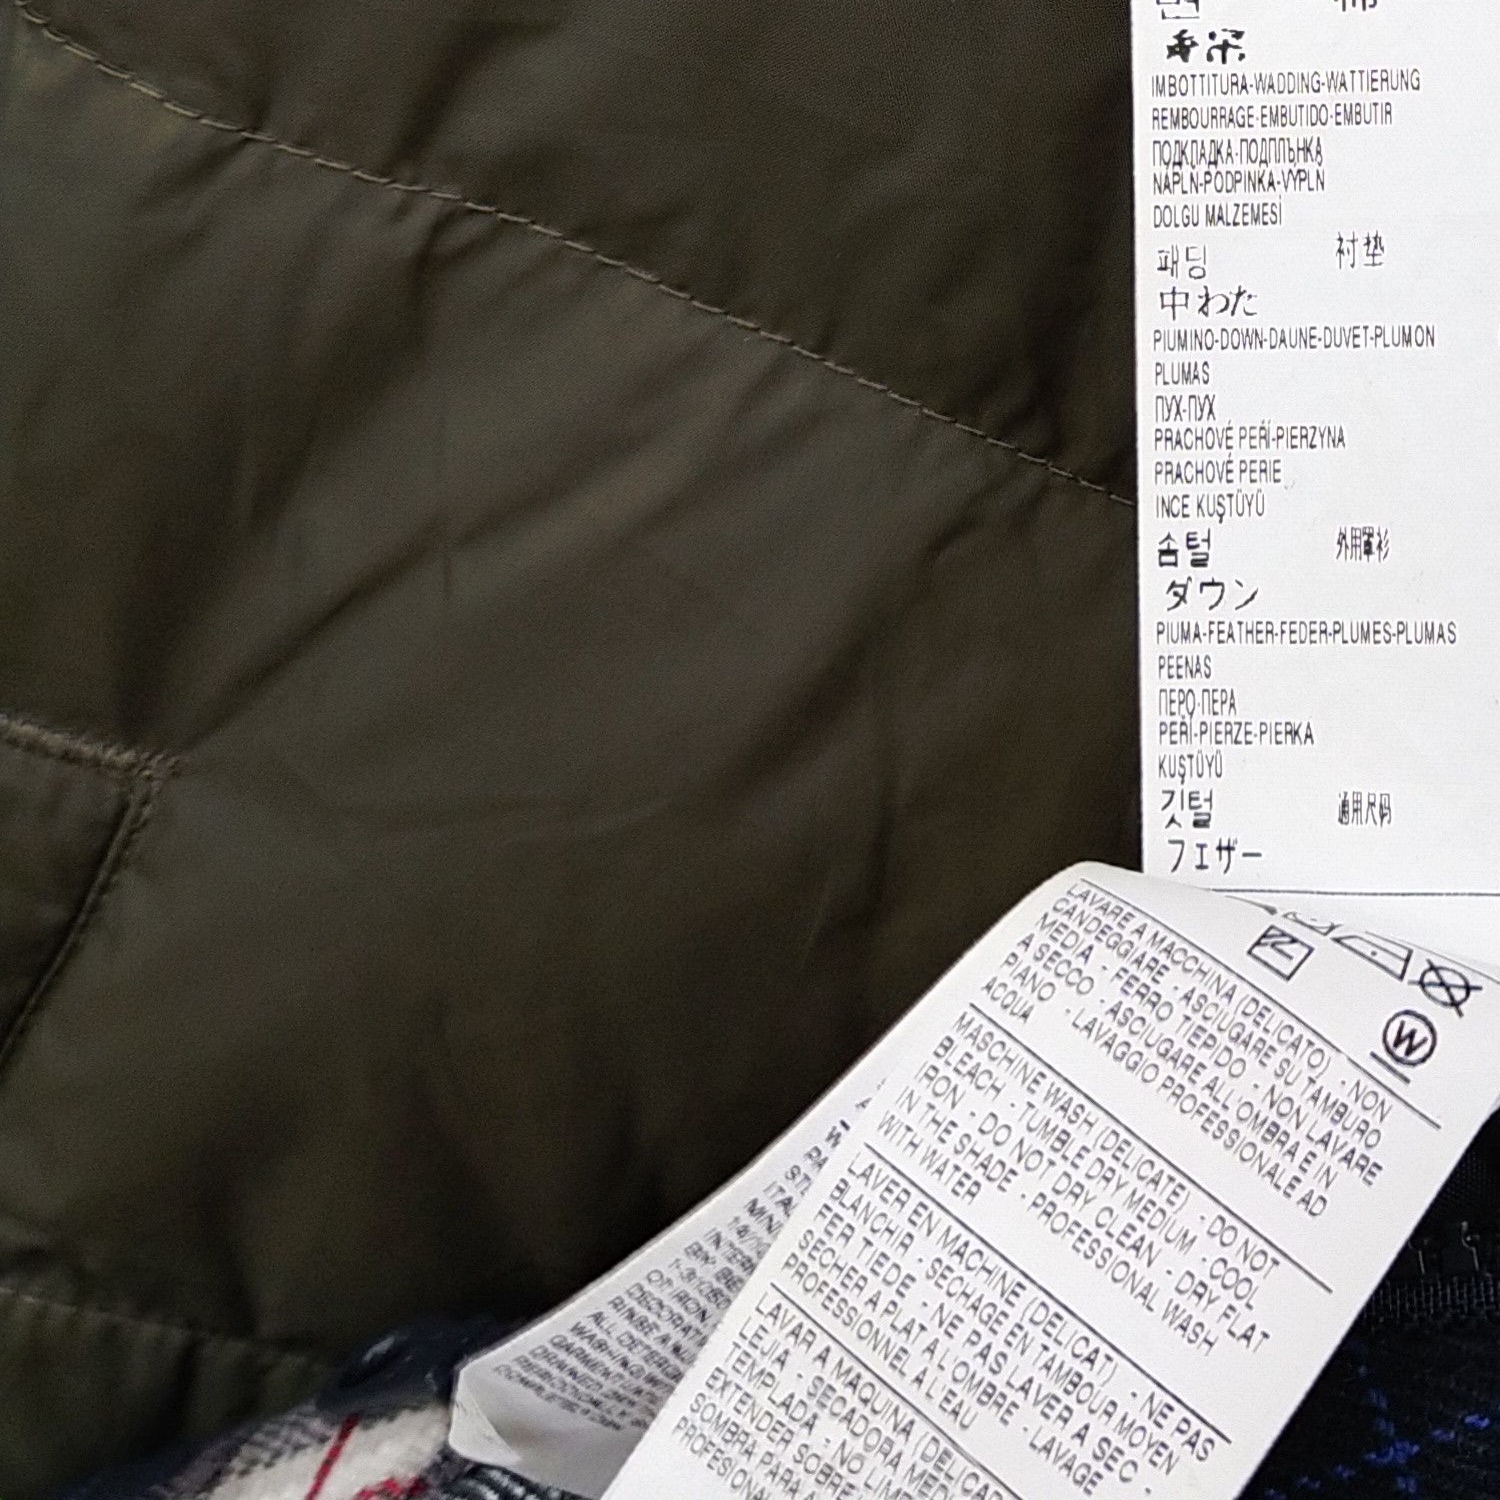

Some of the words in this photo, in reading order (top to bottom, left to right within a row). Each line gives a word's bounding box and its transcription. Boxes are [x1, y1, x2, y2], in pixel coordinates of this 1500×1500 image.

[1153, 203, 1200, 229] DOLGU
[1159, 285, 1258, 322] 中わた
[1154, 360, 1210, 387] PLUMAS
[1154, 418, 1234, 452] PRACHOVÉ
[1154, 451, 1235, 486] PRACHOVÉ
[1238, 458, 1282, 485] PERIE
[1196, 487, 1265, 525] KUŞTÜYÜ
[1165, 575, 1259, 613] ダウン
[1158, 748, 1223, 786] KUŞTÜYÜ
[1160, 787, 1214, 830] 깃털
[1167, 836, 1263, 875] フェザー
[980, 975, 1034, 1024] ACQUA
[1051, 896, 1171, 985] CANDEGGIARE
[1178, 985, 1278, 1068] ASCIUGARE
[1300, 1074, 1382, 1150] TAMBURO
[1066, 882, 1136, 930] LAVARE
[1145, 929, 1238, 1005] MACCHINA
[1232, 993, 1332, 1078] (DELICATO)
[1002, 950, 1056, 1002] PIANO
[1070, 1007, 1160, 1084] LAVAGGIO
[1159, 1073, 1307, 1199] PROFESSIONALE
[1031, 942, 1095, 996] SECCO
[1103, 999, 1208, 1085] ASCIUGARE
[1199, 1074, 1301, 1163] ALL'OMBRA
[1038, 910, 1095, 965] MEDIA
[1109, 965, 1174, 1023] FERRO
[1174, 1013, 1247, 1079] TIEPIDO
[1304, 1119, 1384, 1187] LAVARE
[931, 1034, 1003, 1100] BLEACH
[1020, 1099, 1092, 1171] TUMBLE
[1121, 1186, 1198, 1255] MEDIUM
[955, 1010, 1048, 1095] MASCHINE
[1042, 1080, 1099, 1135] WASH
[1091, 1125, 1191, 1214] (DELICATE)
[918, 1145, 982, 1205] WATER
[952, 1132, 1019, 1193] SHADE
[1029, 1190, 1160, 1313] PROFESSIONAL
[845, 1160, 912, 1213] LAVER
[935, 1224, 1027, 1309] MACHINE
[1018, 1296, 1118, 1387] (DELICAT)
[1093, 1205, 1162, 1269] CLEAN
[753, 1297, 817, 1354] LAVAR
[832, 1355, 916, 1444] MAQUINA
[780, 1251, 911, 1378] PROFESSIONNEL
[923, 1376, 977, 1431] L'EAU
[797, 1228, 869, 1298] SECHER
[935, 1347, 1020, 1426] L'OMBRE
[1027, 1426, 1104, 1495] LAVAGE
[828, 1176, 915, 1257] BLANCHIR
[924, 1256, 1010, 1336] SECHAGE
[1031, 1341, 1119, 1426] TAMBOUR
[1112, 1410, 1180, 1476] MOYEN
[856, 1236, 917, 1299] TIEDE
[1004, 1363, 1074, 1431] LAVER
[688, 1391, 758, 1462] SOMBRA
[704, 1365, 796, 1451] EXTENDER
[728, 1340, 819, 1437] TEMPLADA
[737, 1316, 790, 1372] LEJIA
[805, 1374, 903, 1473] SECADORA
